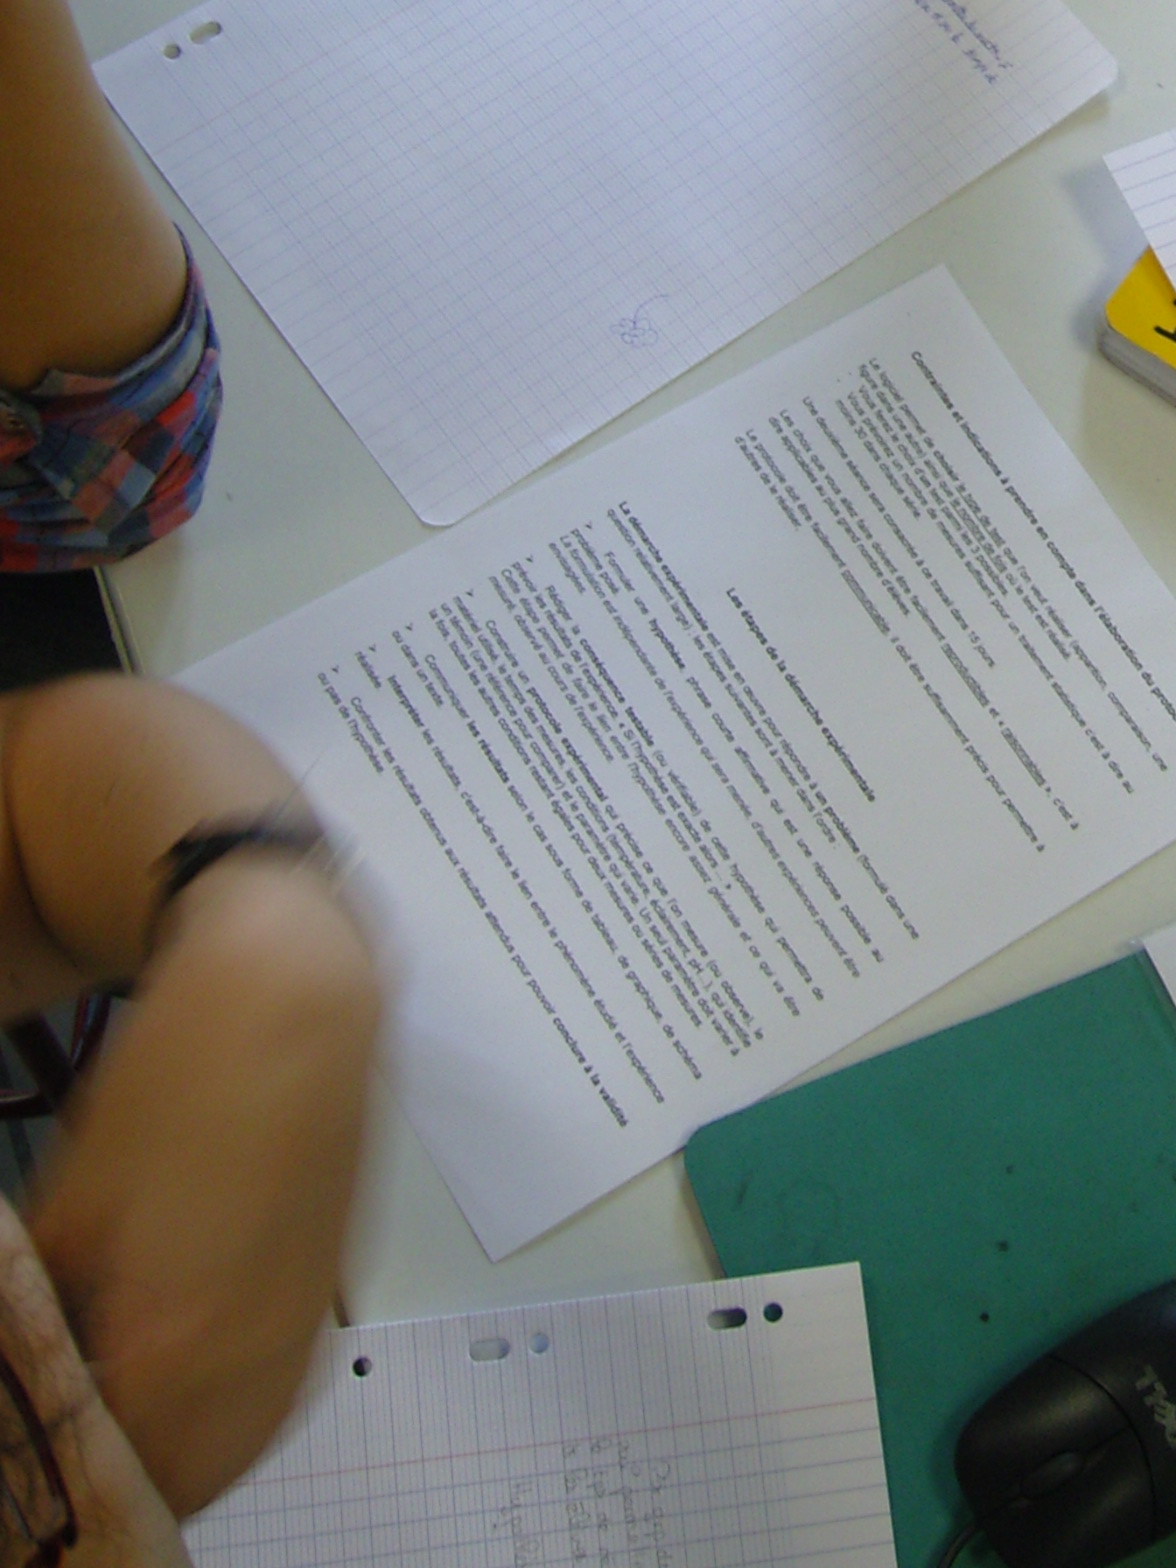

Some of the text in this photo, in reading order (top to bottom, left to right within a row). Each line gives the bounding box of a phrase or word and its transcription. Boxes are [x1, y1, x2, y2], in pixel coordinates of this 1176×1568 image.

[909, 350, 956, 411] Contraintes
[959, 421, 1003, 478] indications
[1004, 484, 1039, 526] prendre
[1044, 540, 1078, 581] compte
[1073, 579, 1097, 607] dans
[385, 674, 426, 729] Interpréter
[578, 637, 627, 705] conséquence
[624, 705, 655, 747] testable
[627, 515, 664, 564] démarche
[659, 563, 710, 632] expérimentale
[822, 805, 861, 855] problème
[725, 587, 745, 610] Les
[739, 609, 769, 647] étapes
[783, 672, 825, 727] démarche
[819, 725, 877, 803] expérimentale
[466, 720, 481, 738] les
[477, 738, 511, 784] résultats
[525, 686, 564, 735] protocole
[559, 736, 608, 803] expérimental
[552, 1016, 587, 1065] conclure
[598, 1086, 629, 1128] validité
